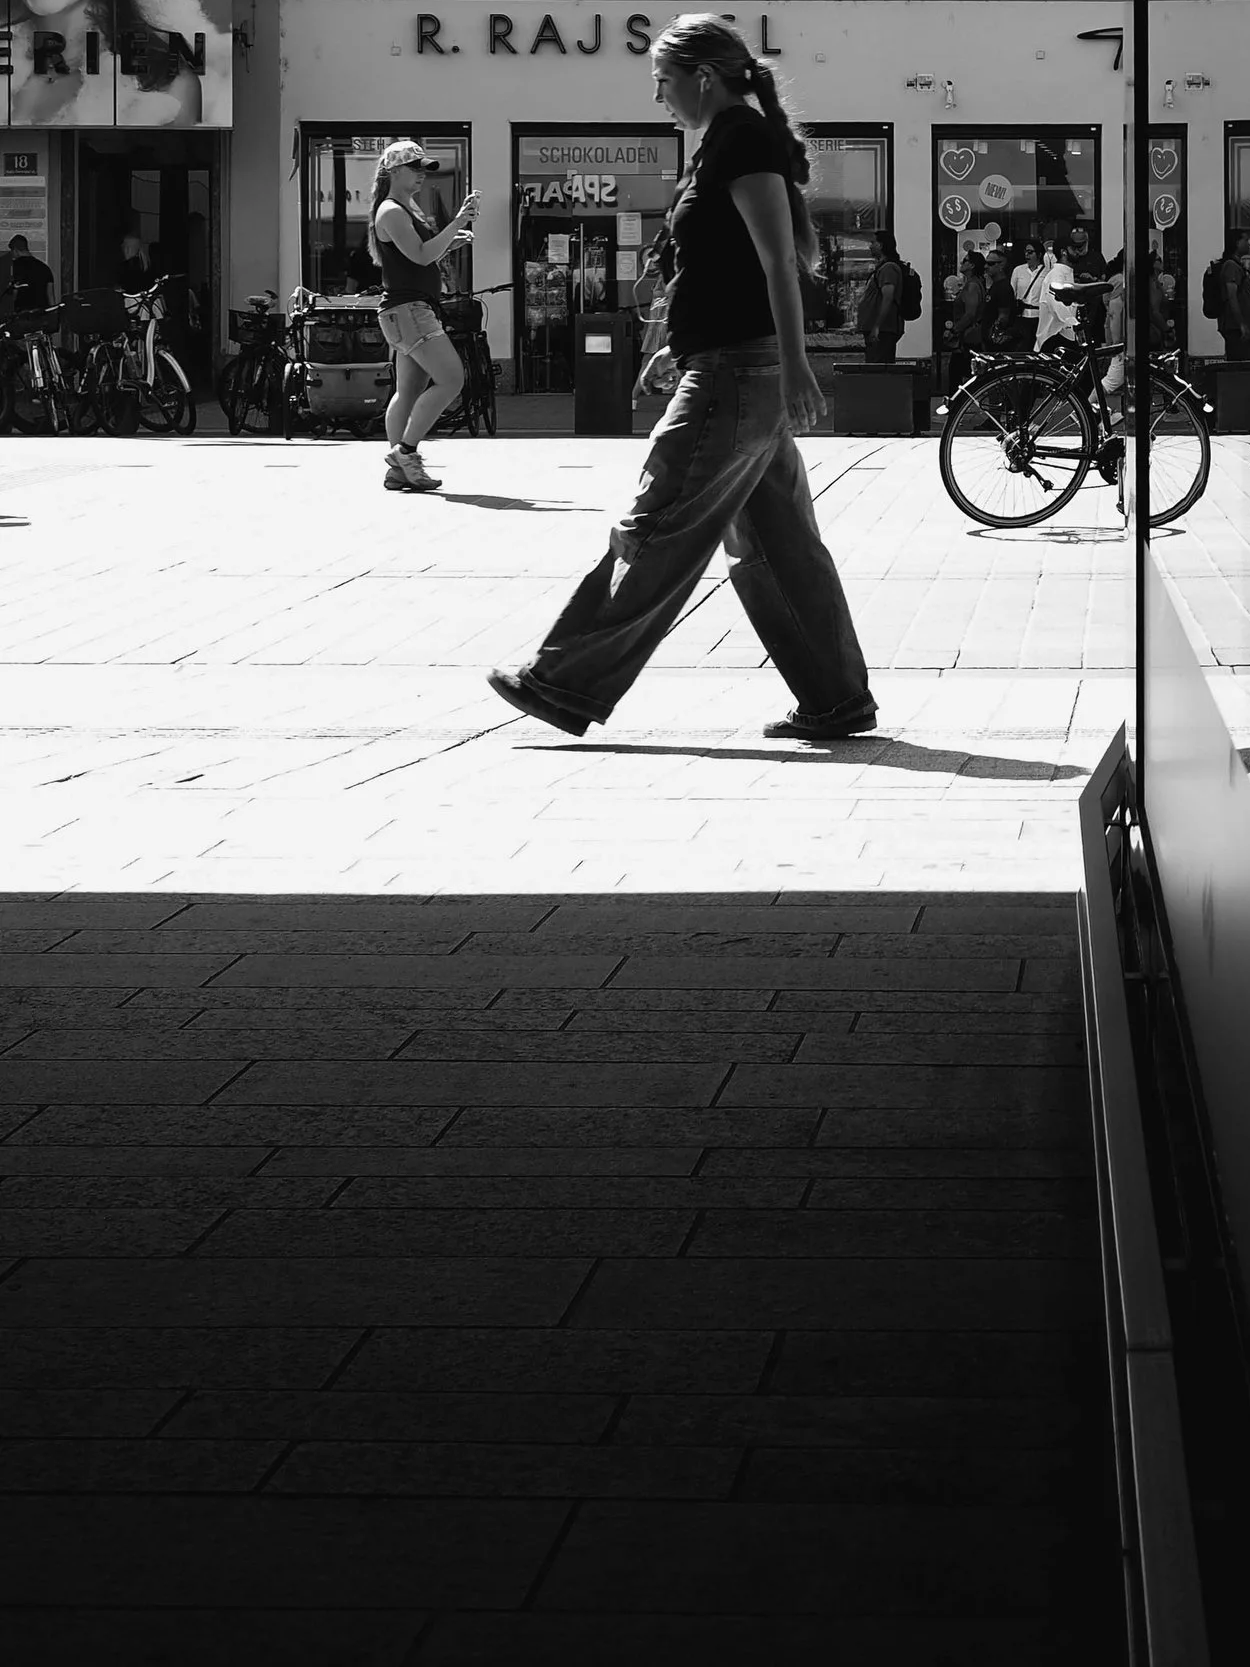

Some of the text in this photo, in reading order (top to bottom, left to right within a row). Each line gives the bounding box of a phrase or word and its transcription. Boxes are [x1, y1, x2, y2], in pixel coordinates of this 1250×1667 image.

[416, 13, 782, 54] R. RAJSL
[14, 154, 29, 169] 18
[538, 146, 659, 164] SCHOKOLADEN
